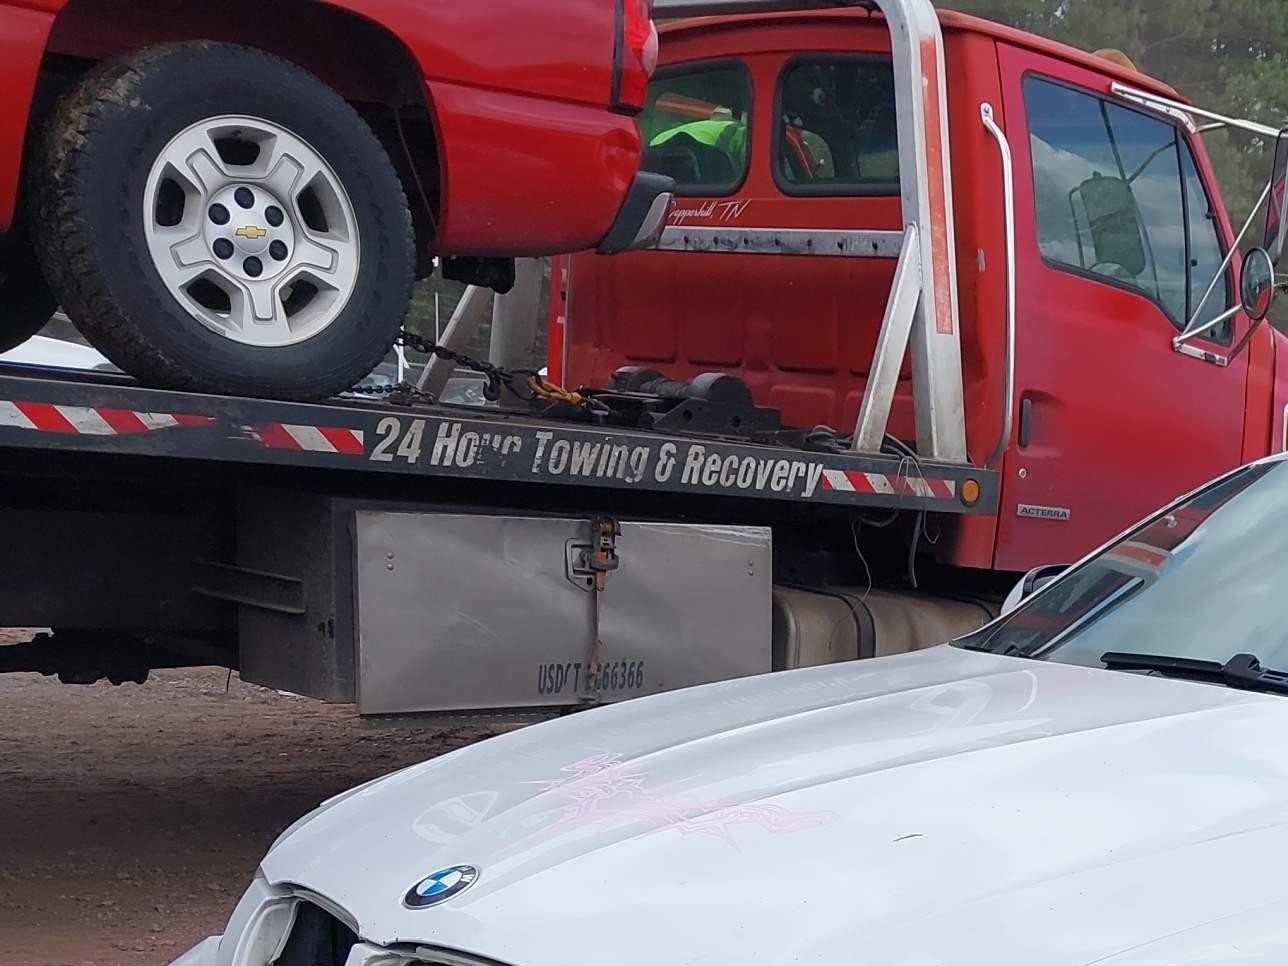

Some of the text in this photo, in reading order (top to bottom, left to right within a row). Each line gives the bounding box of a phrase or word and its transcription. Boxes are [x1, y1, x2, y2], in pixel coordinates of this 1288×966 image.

[718, 199, 752, 222] TN
[369, 416, 426, 464] 24
[531, 430, 649, 484] Towing
[654, 442, 677, 483] &
[681, 444, 825, 498] Recovery
[1020, 506, 1068, 518] ACTERRA
[585, 661, 645, 691] 66366
